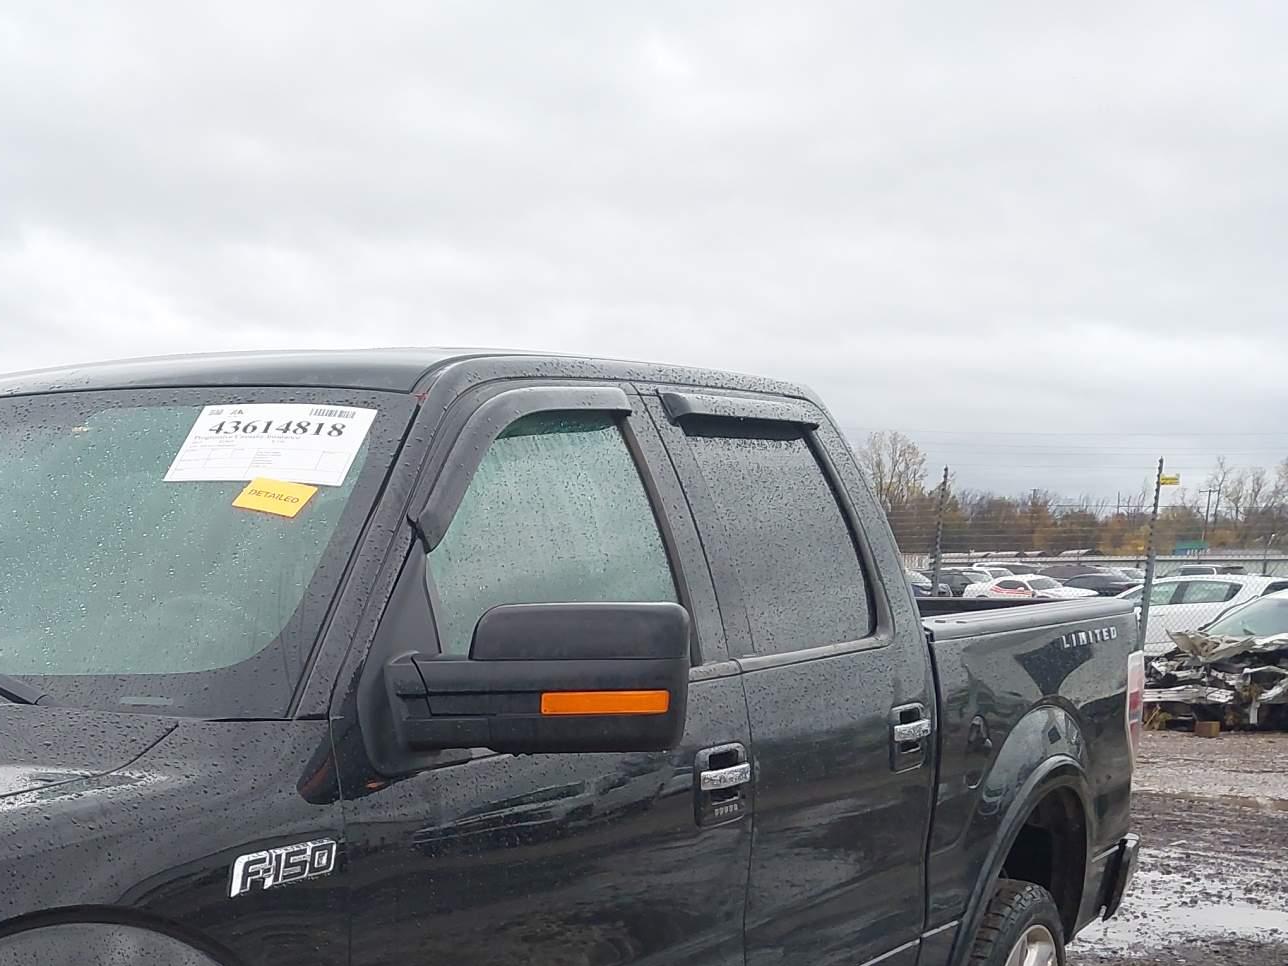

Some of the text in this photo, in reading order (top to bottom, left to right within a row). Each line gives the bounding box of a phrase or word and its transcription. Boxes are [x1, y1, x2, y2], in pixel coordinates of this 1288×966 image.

[208, 419, 346, 438] 43614818
[247, 488, 300, 504] DETAILED
[1061, 626, 1117, 649] LIMITED
[230, 838, 337, 898] F-150
